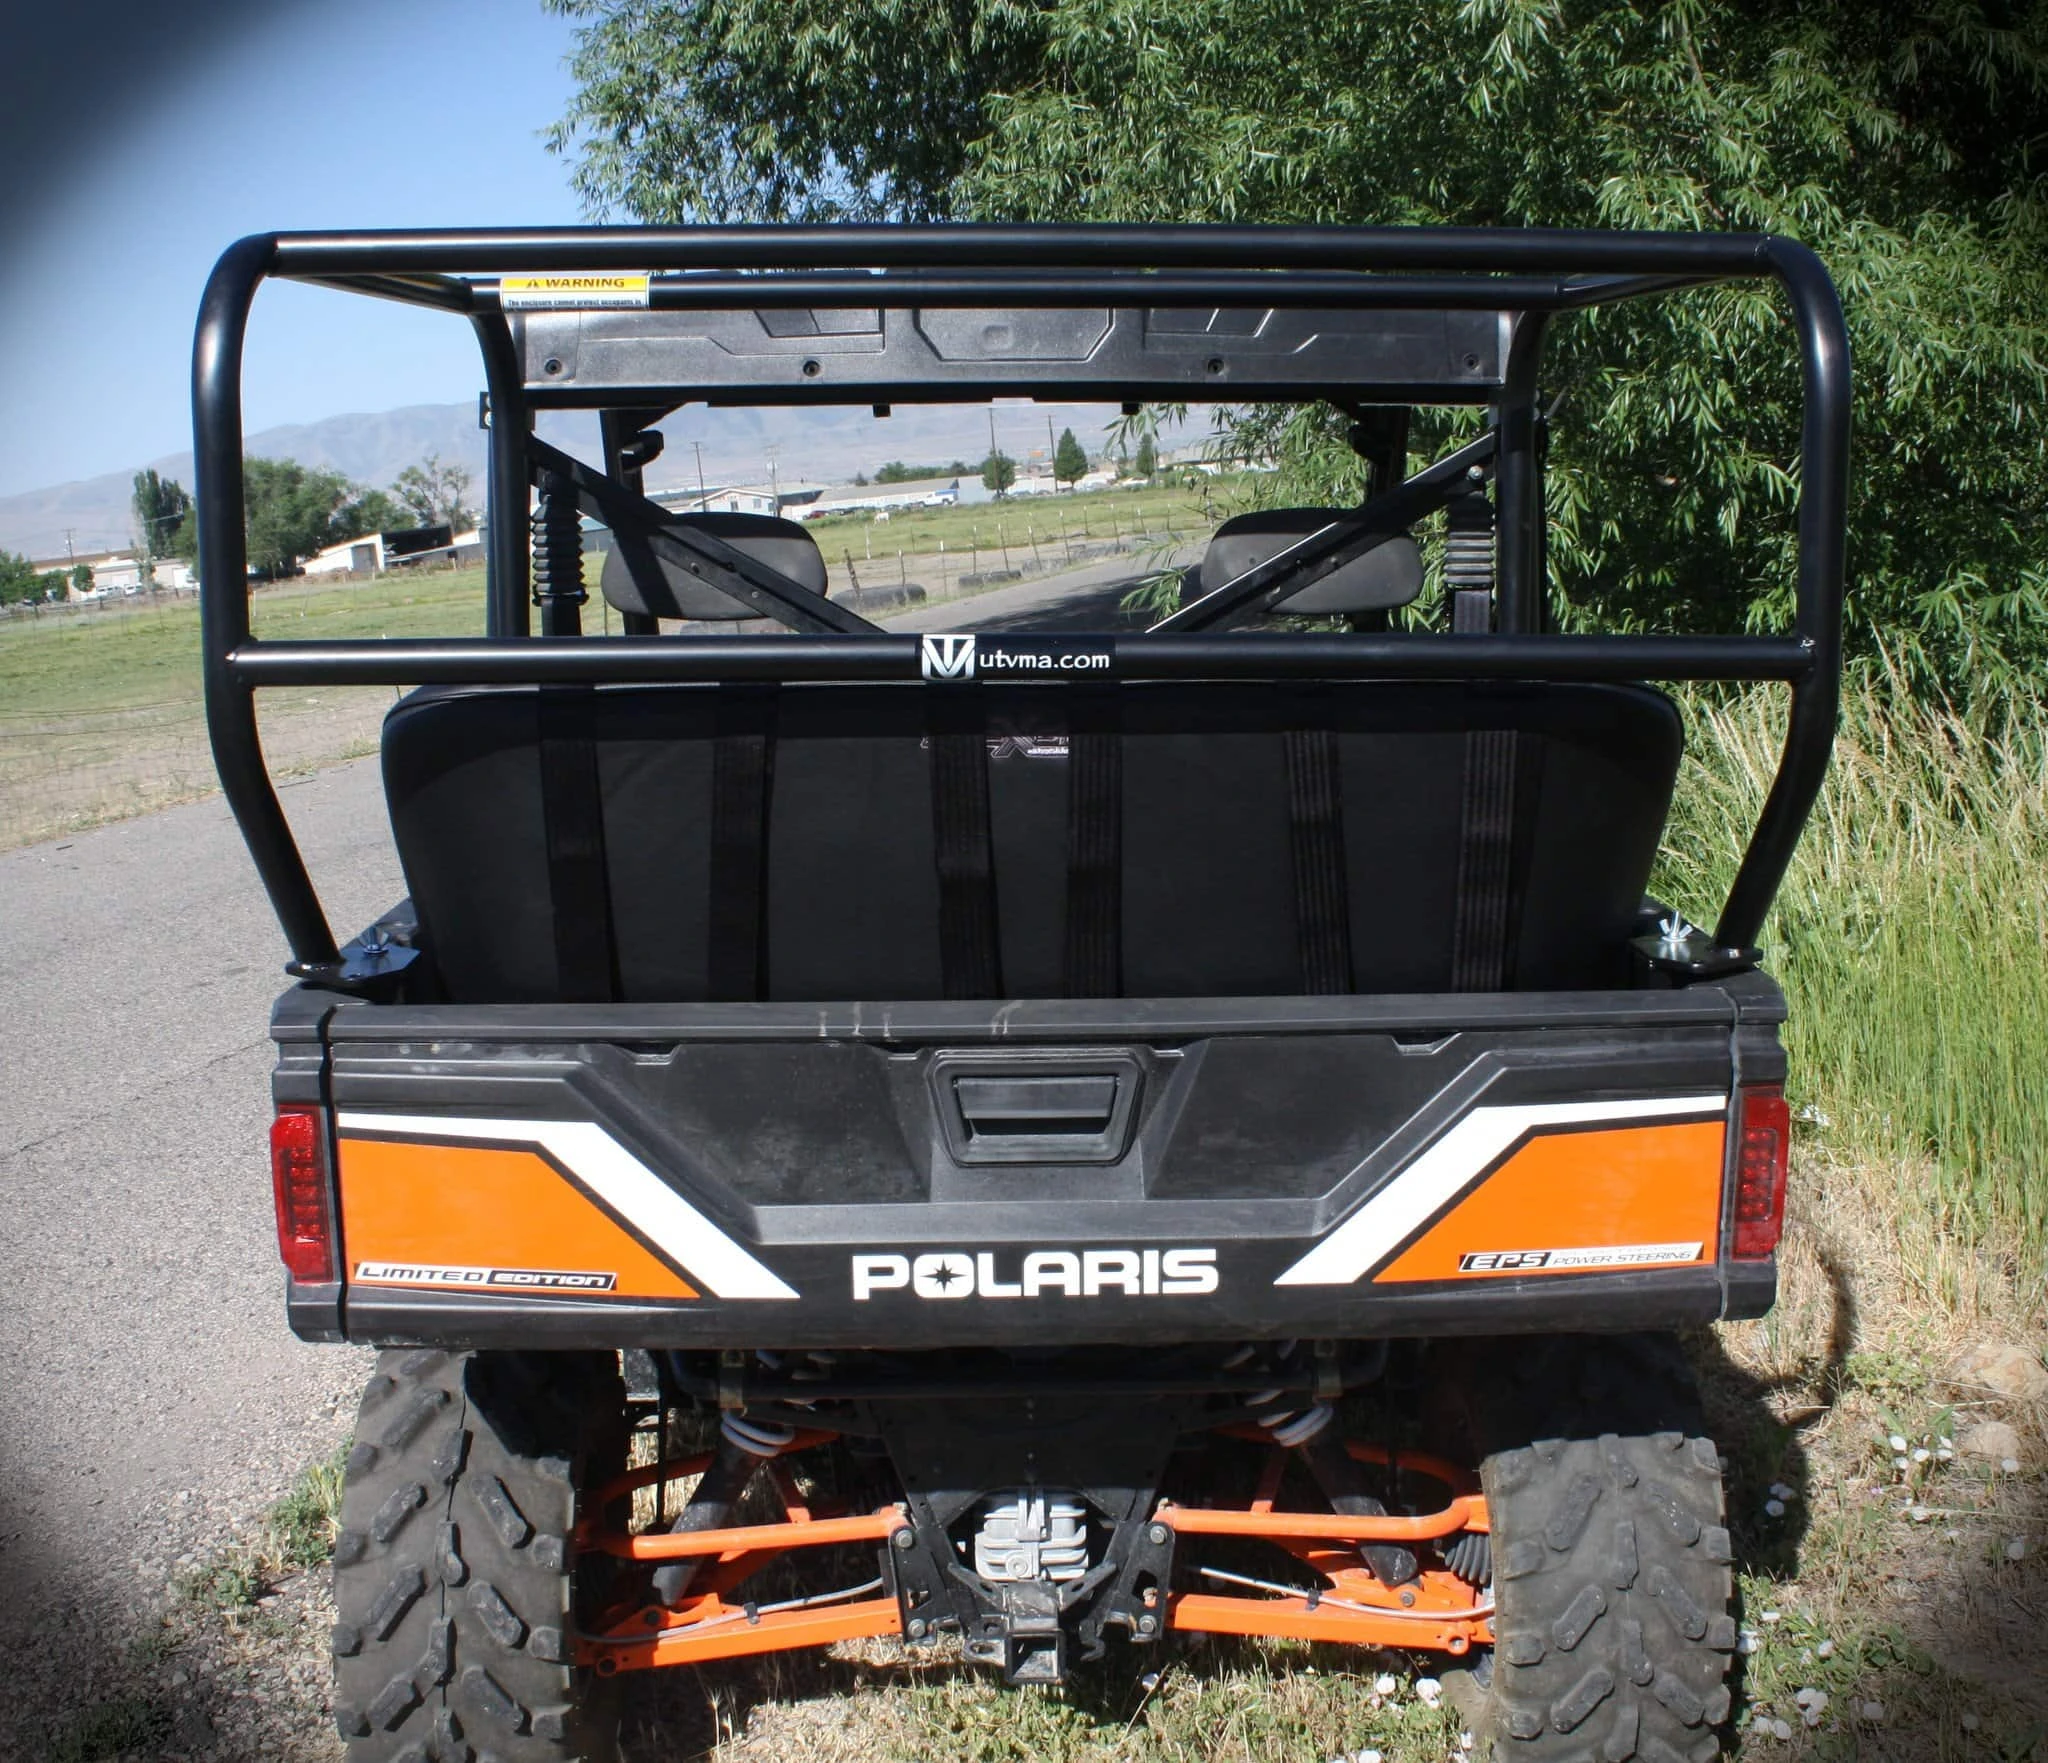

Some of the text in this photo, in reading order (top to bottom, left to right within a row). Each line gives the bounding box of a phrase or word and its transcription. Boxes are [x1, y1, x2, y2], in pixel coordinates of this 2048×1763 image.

[546, 278, 625, 288] WARNING
[979, 649, 1110, 669] utvma.com
[1470, 1253, 1545, 1270] EPS
[1553, 1255, 1612, 1265] POWER
[1616, 1250, 1693, 1263] STEERING
[362, 1266, 606, 1287] LIMITED EDITION
[852, 1248, 1219, 1300] POLARIS
